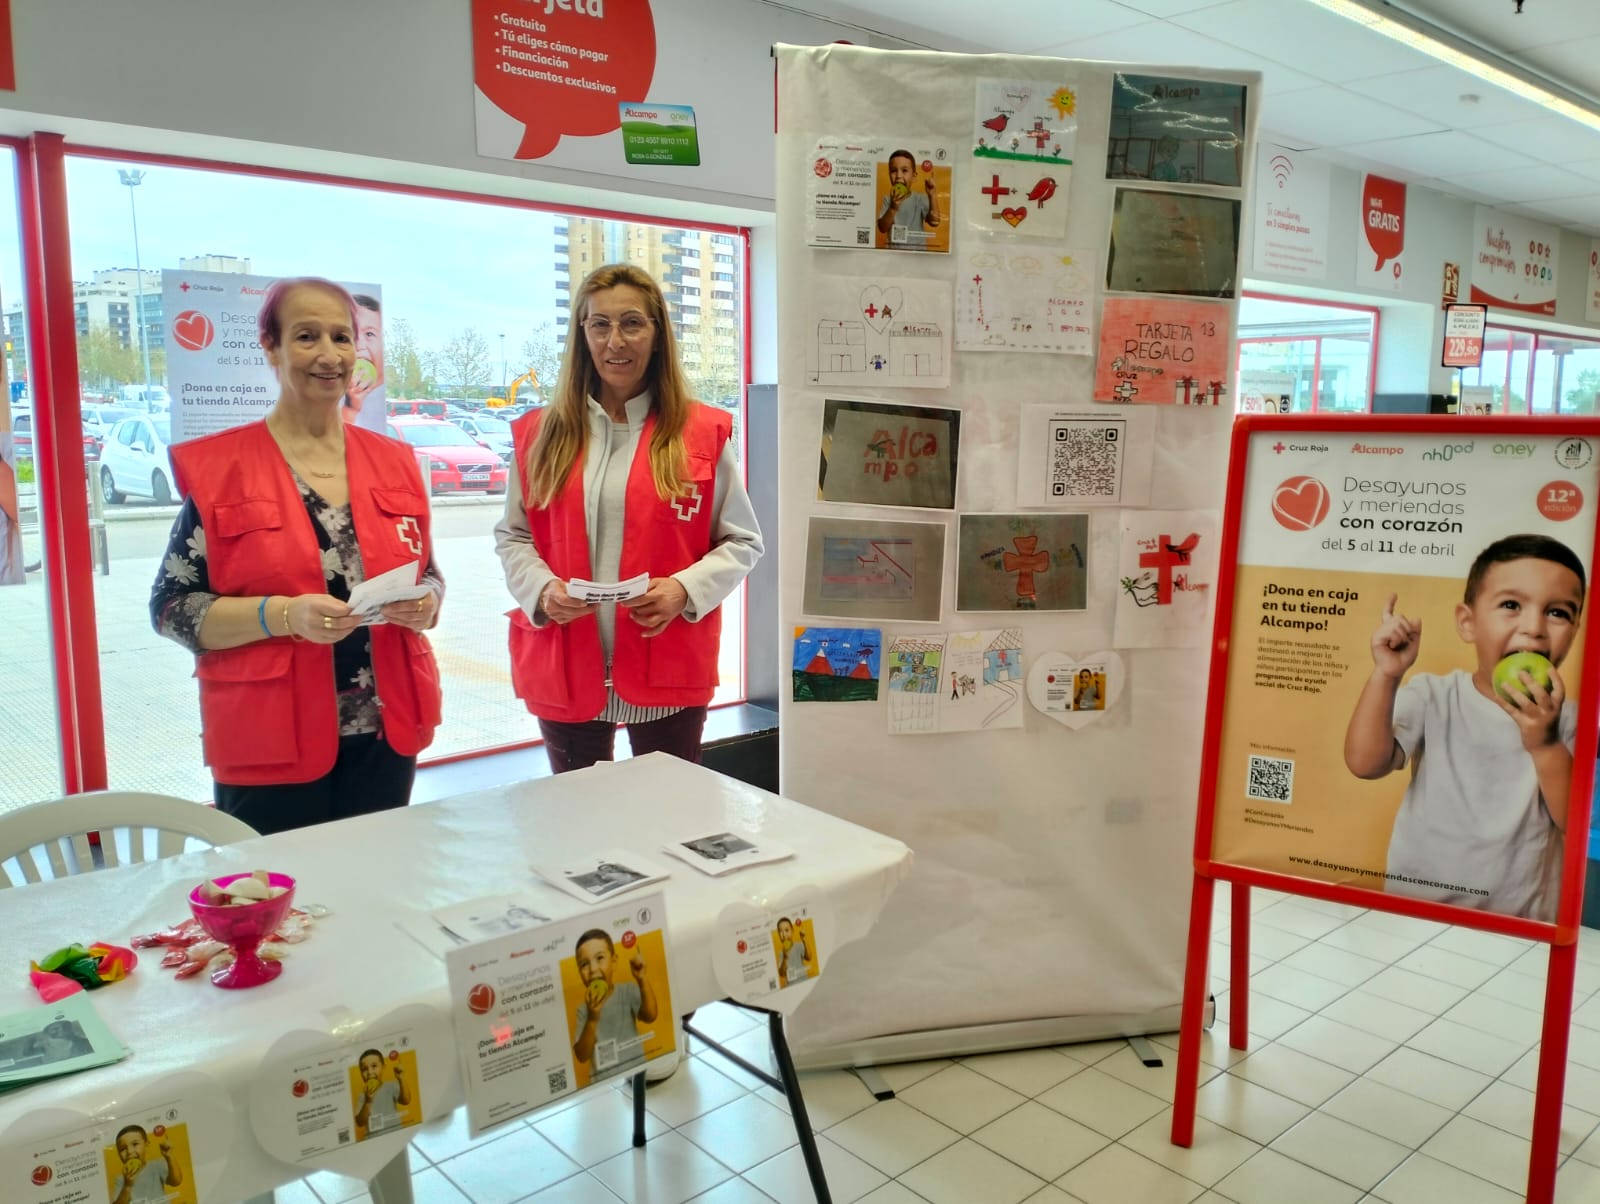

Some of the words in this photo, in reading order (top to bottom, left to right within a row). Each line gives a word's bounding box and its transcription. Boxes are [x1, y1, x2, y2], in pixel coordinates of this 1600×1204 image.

[501, 13, 546, 32] Gratuita
[501, 29, 515, 43] Tú
[517, 33, 548, 51] eliges
[550, 40, 577, 54] cómo
[579, 48, 608, 62] pagar
[502, 46, 568, 69] Financiación
[503, 63, 563, 83] Descuentos
[565, 76, 616, 94] exclusivos
[625, 107, 657, 119] Alcampo
[1368, 210, 1400, 233] GRATIS
[240, 286, 268, 296] Alcam
[222, 328, 230, 338] y
[1136, 322, 1192, 341] TARJETA
[222, 340, 246, 349] con
[1124, 340, 1194, 362] REGALO
[217, 356, 231, 365] del
[234, 356, 240, 365] 5
[254, 357, 264, 366] 11
[181, 383, 213, 394] ¡Dona
[215, 385, 228, 393] en
[230, 383, 252, 395] caja
[254, 385, 267, 393] en
[182, 397, 194, 406] tu
[196, 396, 230, 406] tienda
[1289, 444, 1309, 452] Cruz
[1310, 444, 1329, 453] Roja
[1352, 442, 1404, 456] Alcampo
[1492, 441, 1536, 459] oney
[1343, 476, 1467, 497] Desayunos
[1547, 488, 1576, 503] 12ª
[1341, 500, 1354, 514] y
[1360, 498, 1465, 515] meriendas
[1543, 501, 1577, 514] edición
[1340, 517, 1374, 529] con
[1381, 517, 1463, 534] corazón
[1321, 538, 1342, 551] del
[1347, 539, 1356, 551] 5
[1360, 540, 1374, 552] al
[1377, 540, 1394, 553] 11
[1399, 541, 1418, 554] de
[1421, 542, 1455, 557] abril
[1263, 583, 1304, 597] ¡Dona
[1307, 588, 1325, 598] en
[1328, 588, 1359, 603] caja
[1262, 601, 1278, 611] en
[1282, 601, 1296, 612] tu
[1300, 602, 1346, 616] tienda
[1260, 615, 1329, 632] Alcampo!
[1255, 672, 1293, 681] programas
[1294, 674, 1303, 682] de
[1304, 677, 1327, 686] ayuda
[1255, 681, 1275, 689] social
[1286, 683, 1302, 691] Cruz
[1289, 854, 1490, 897] www.desayunosymeriendasconcorazon.com
[501, 995, 518, 1006] con
[520, 983, 554, 1000] corazón
